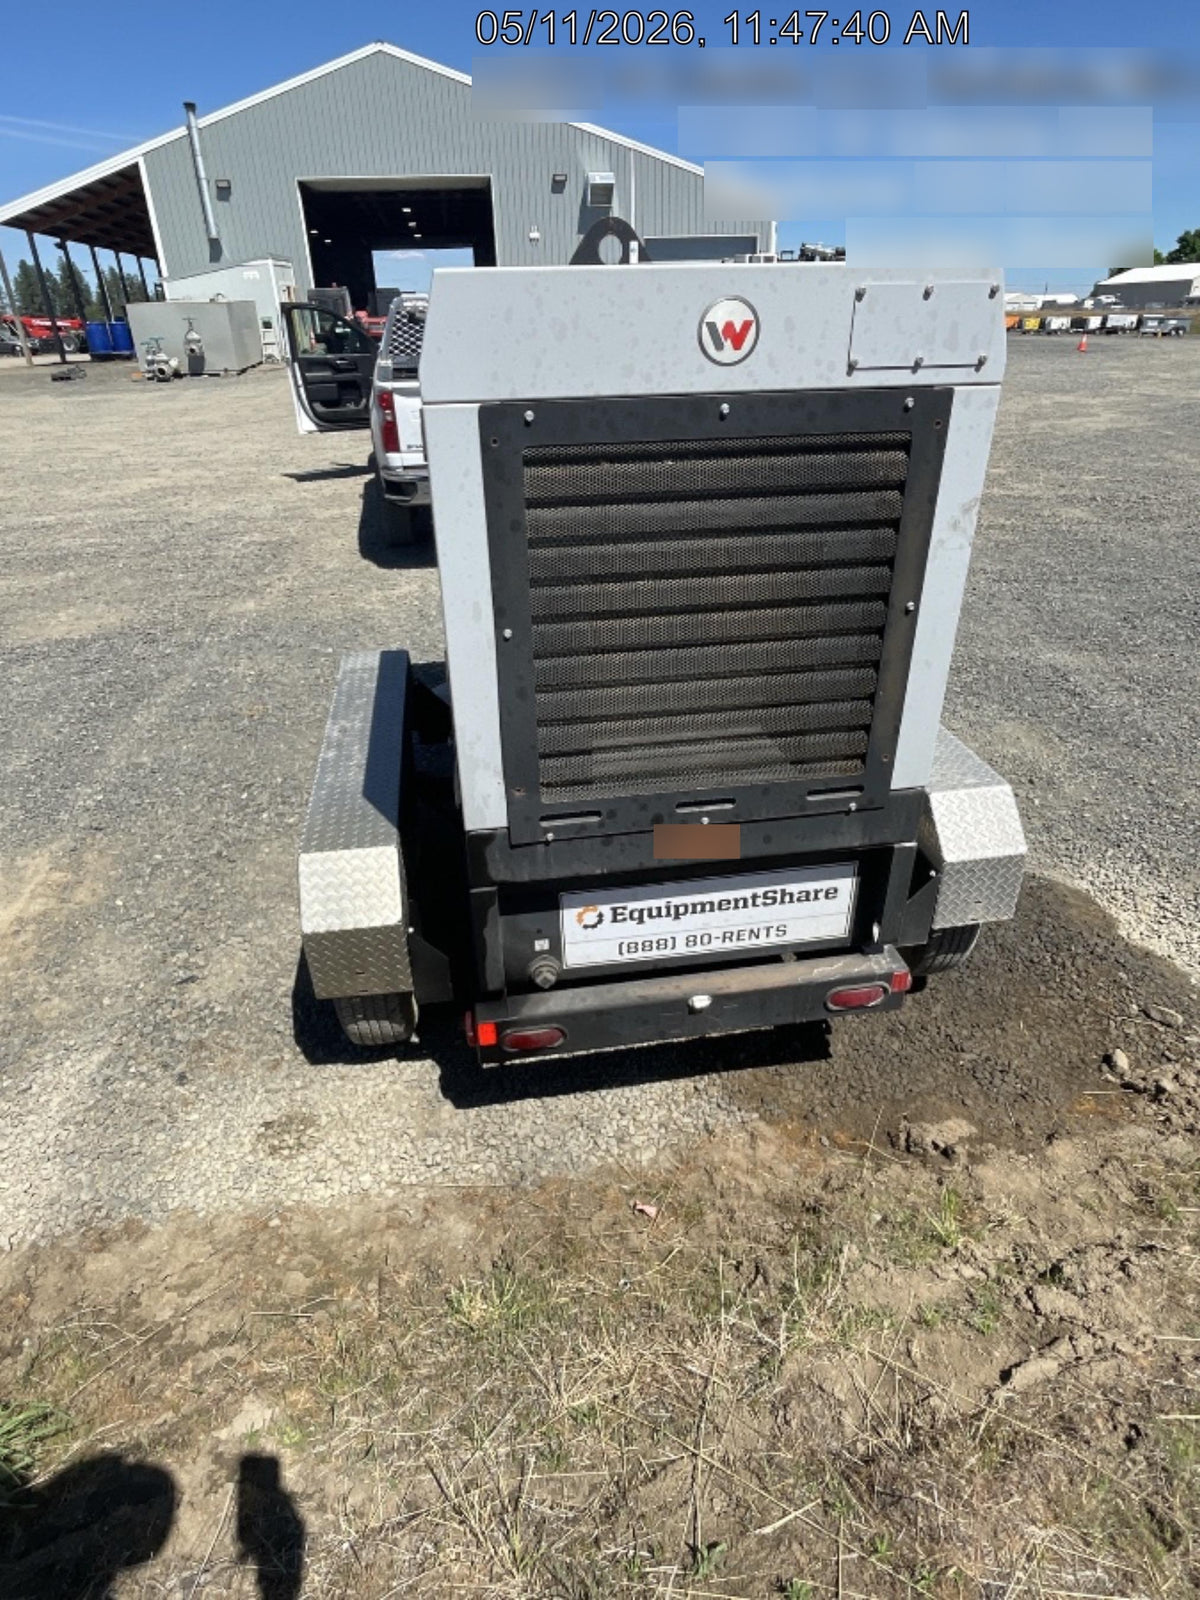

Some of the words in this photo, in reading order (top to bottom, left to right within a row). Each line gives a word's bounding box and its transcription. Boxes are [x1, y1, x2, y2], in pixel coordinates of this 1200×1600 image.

[610, 886, 838, 925] EquipmentShare
[618, 937, 677, 956] (888)
[685, 924, 788, 948] 80-RENTS
